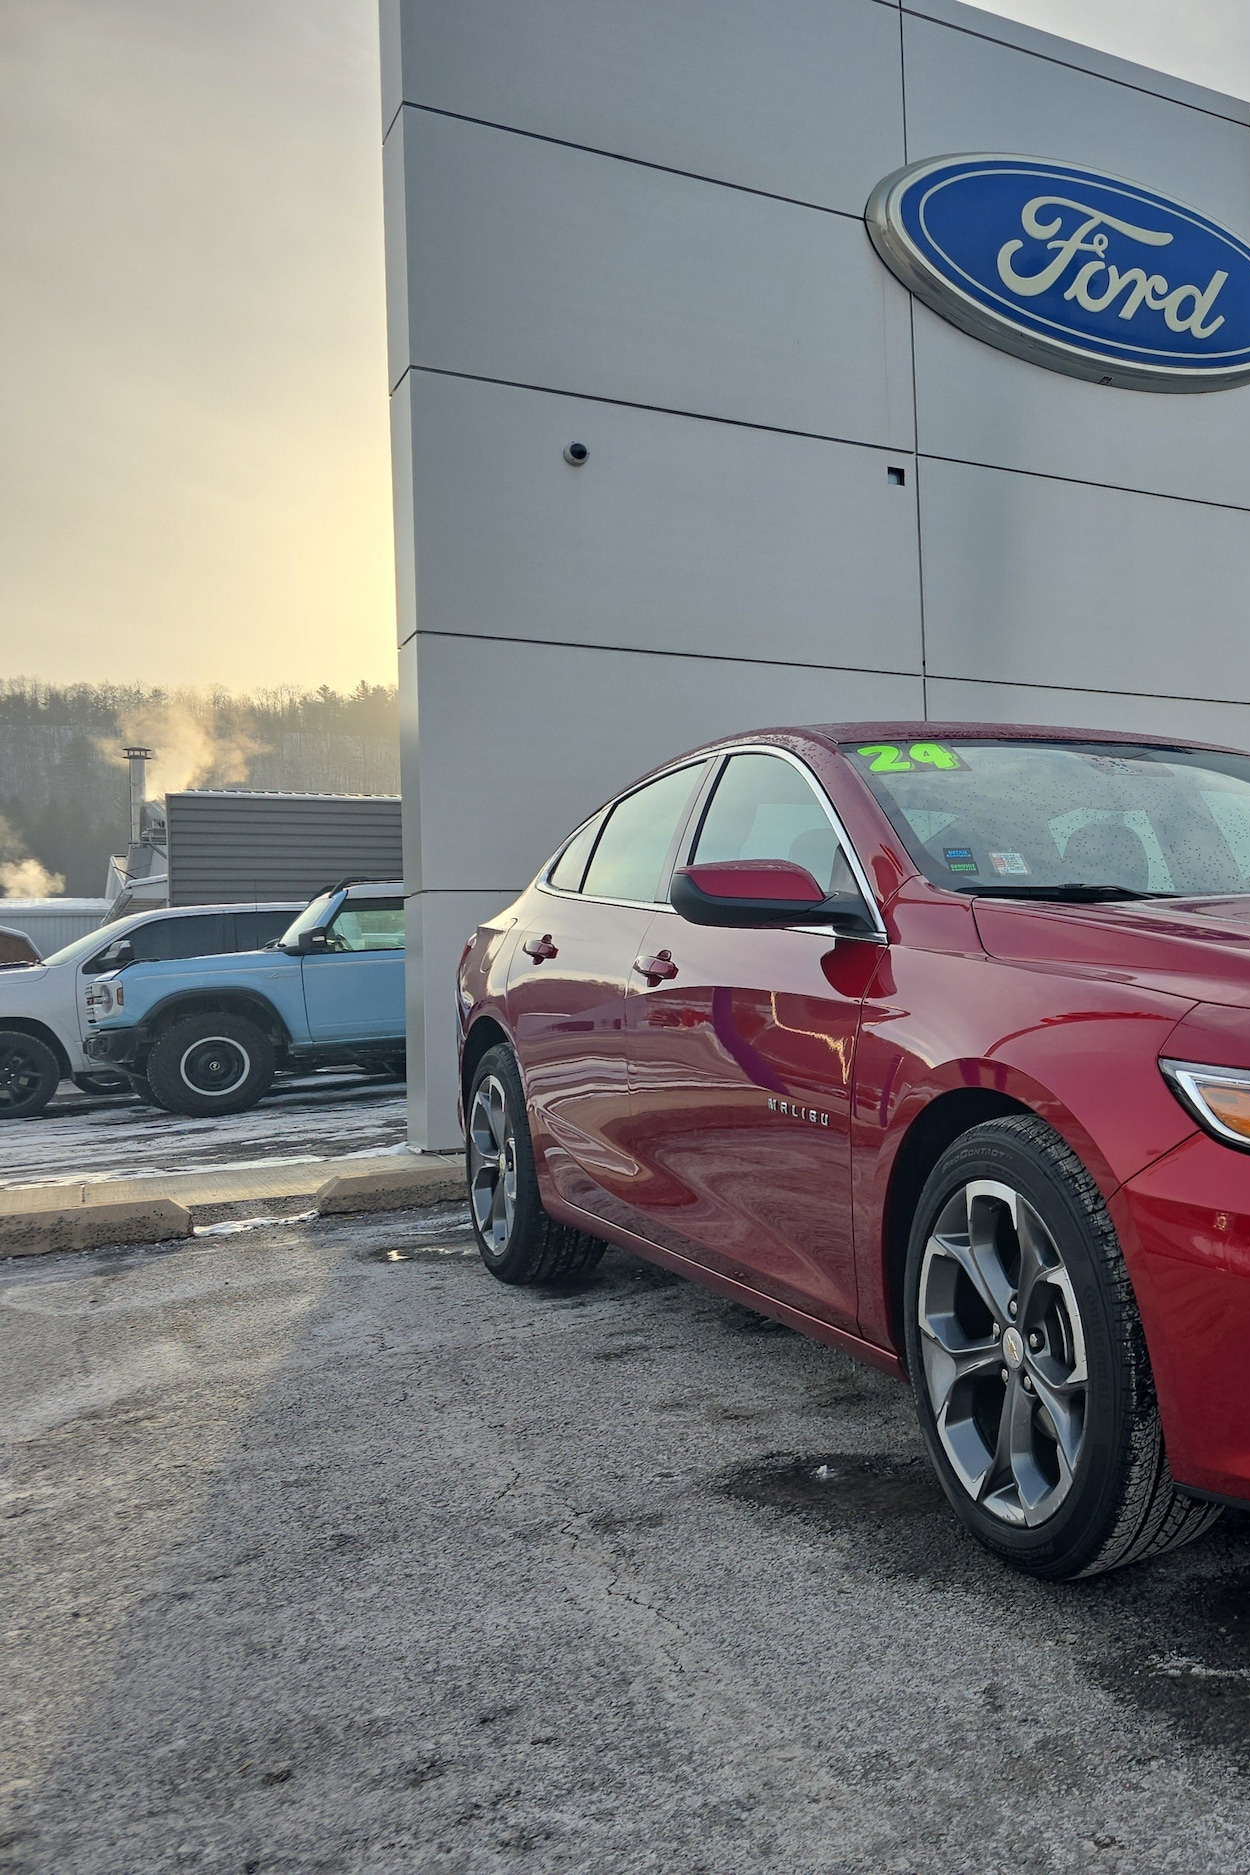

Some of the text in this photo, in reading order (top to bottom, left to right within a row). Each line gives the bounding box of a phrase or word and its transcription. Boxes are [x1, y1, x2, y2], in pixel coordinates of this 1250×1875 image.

[997, 196, 1229, 339] Ford
[857, 743, 960, 772] 24
[768, 1098, 829, 1126] MALIBU
